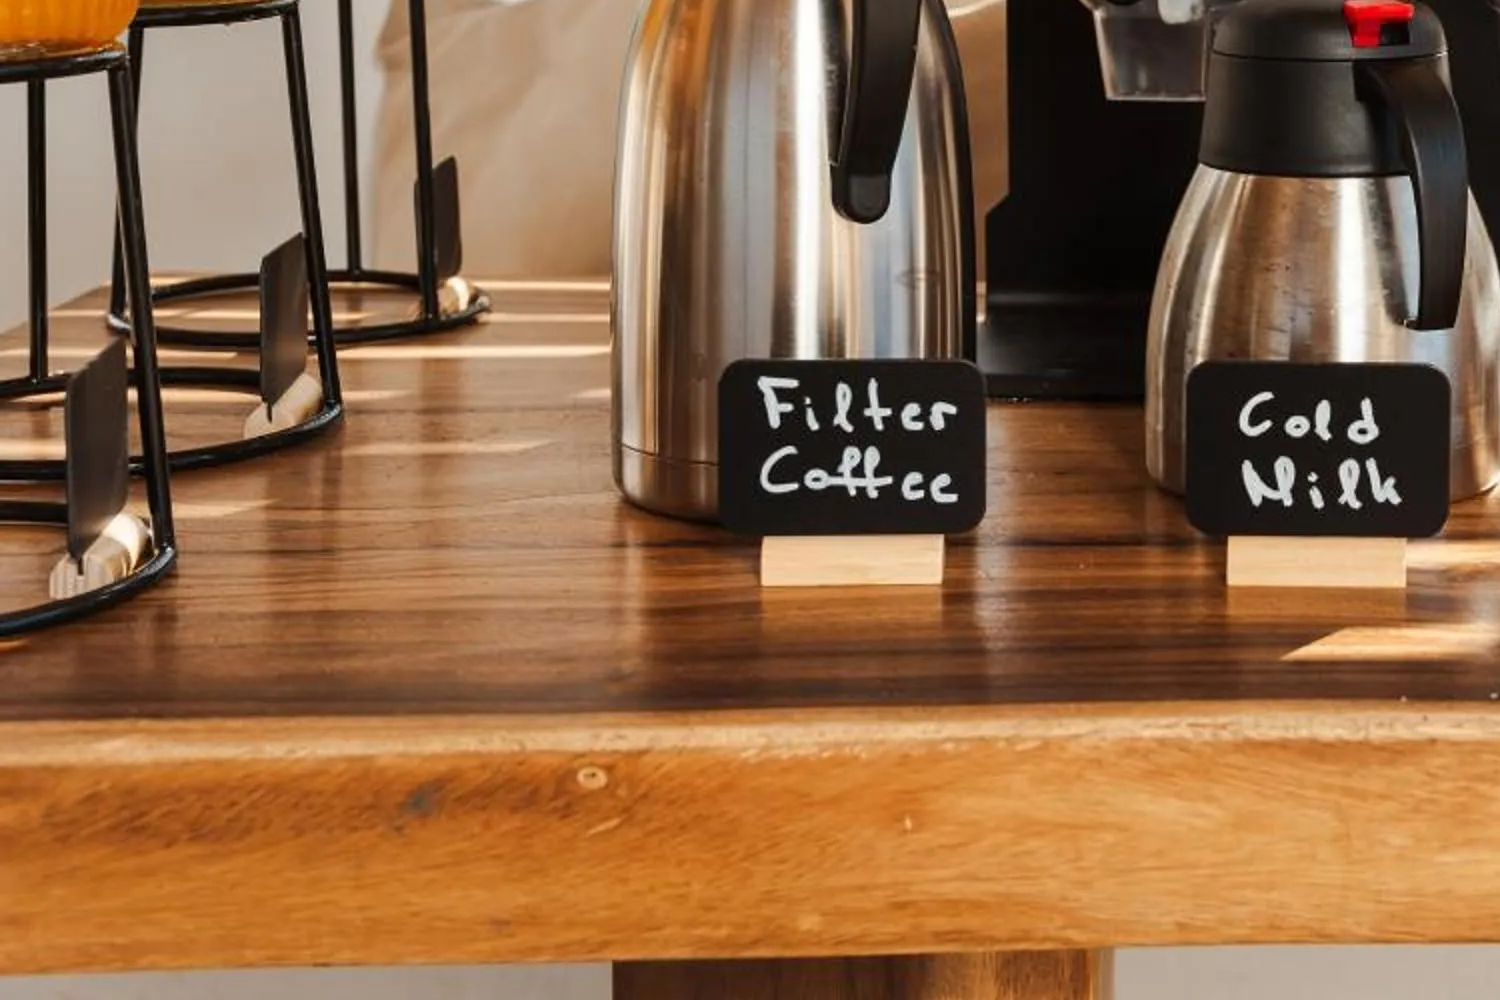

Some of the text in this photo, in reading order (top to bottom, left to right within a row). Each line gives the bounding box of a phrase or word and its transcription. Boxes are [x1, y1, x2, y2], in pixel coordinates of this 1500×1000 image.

[758, 376, 957, 432] Filter
[1239, 392, 1379, 444] Cold
[759, 446, 959, 503] Coffee
[1242, 456, 1402, 509] Milk
